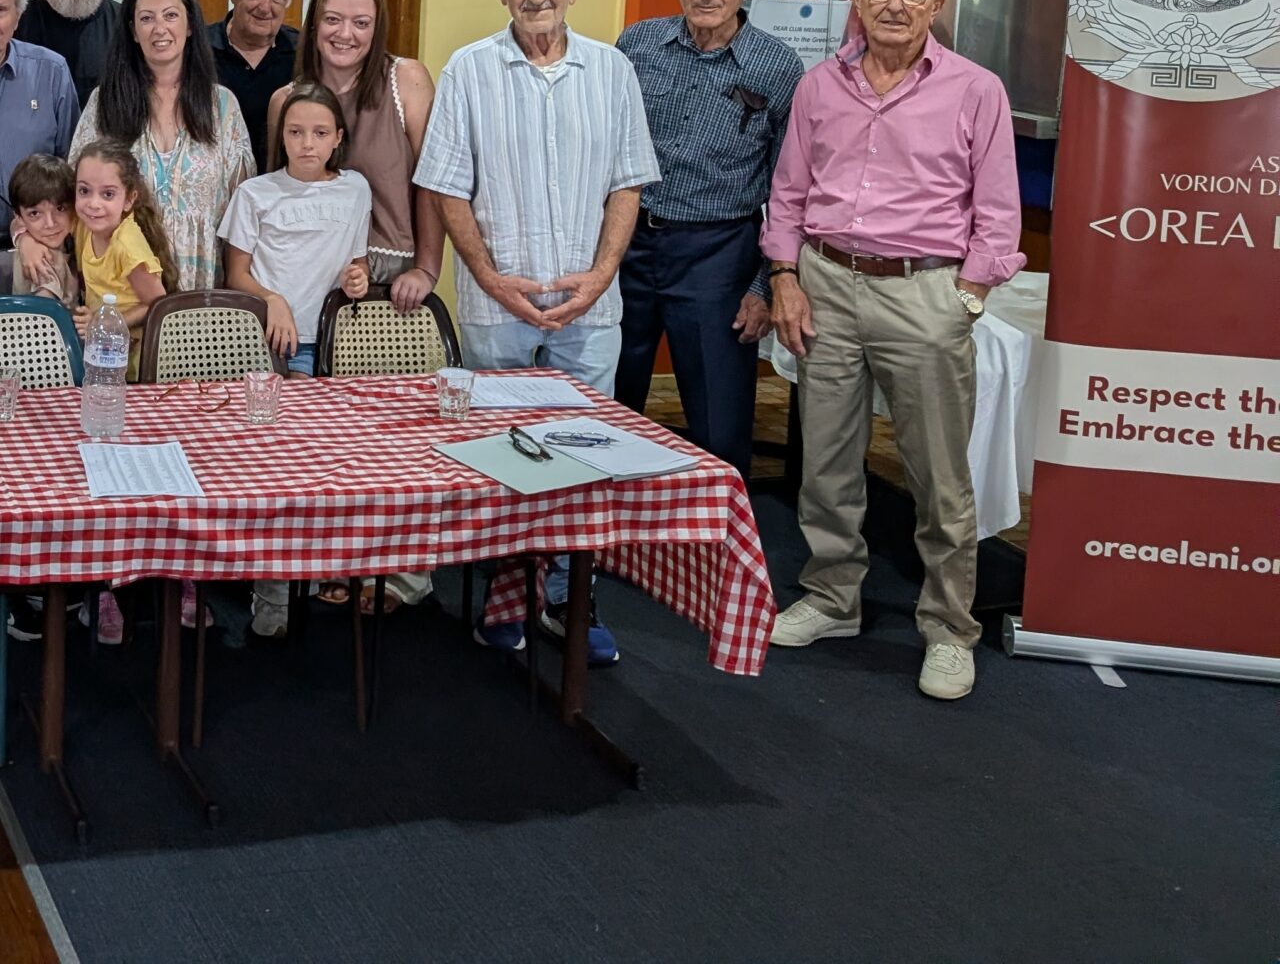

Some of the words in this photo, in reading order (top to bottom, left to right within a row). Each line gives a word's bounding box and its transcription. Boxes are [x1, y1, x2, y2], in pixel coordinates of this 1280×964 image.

[1160, 173, 1252, 195] VORION
[1260, 178, 1280, 196] D
[1087, 375, 1226, 413] Respect
[1239, 386, 1280, 415] th
[1058, 409, 1216, 447] Embrace
[1228, 423, 1280, 453] the
